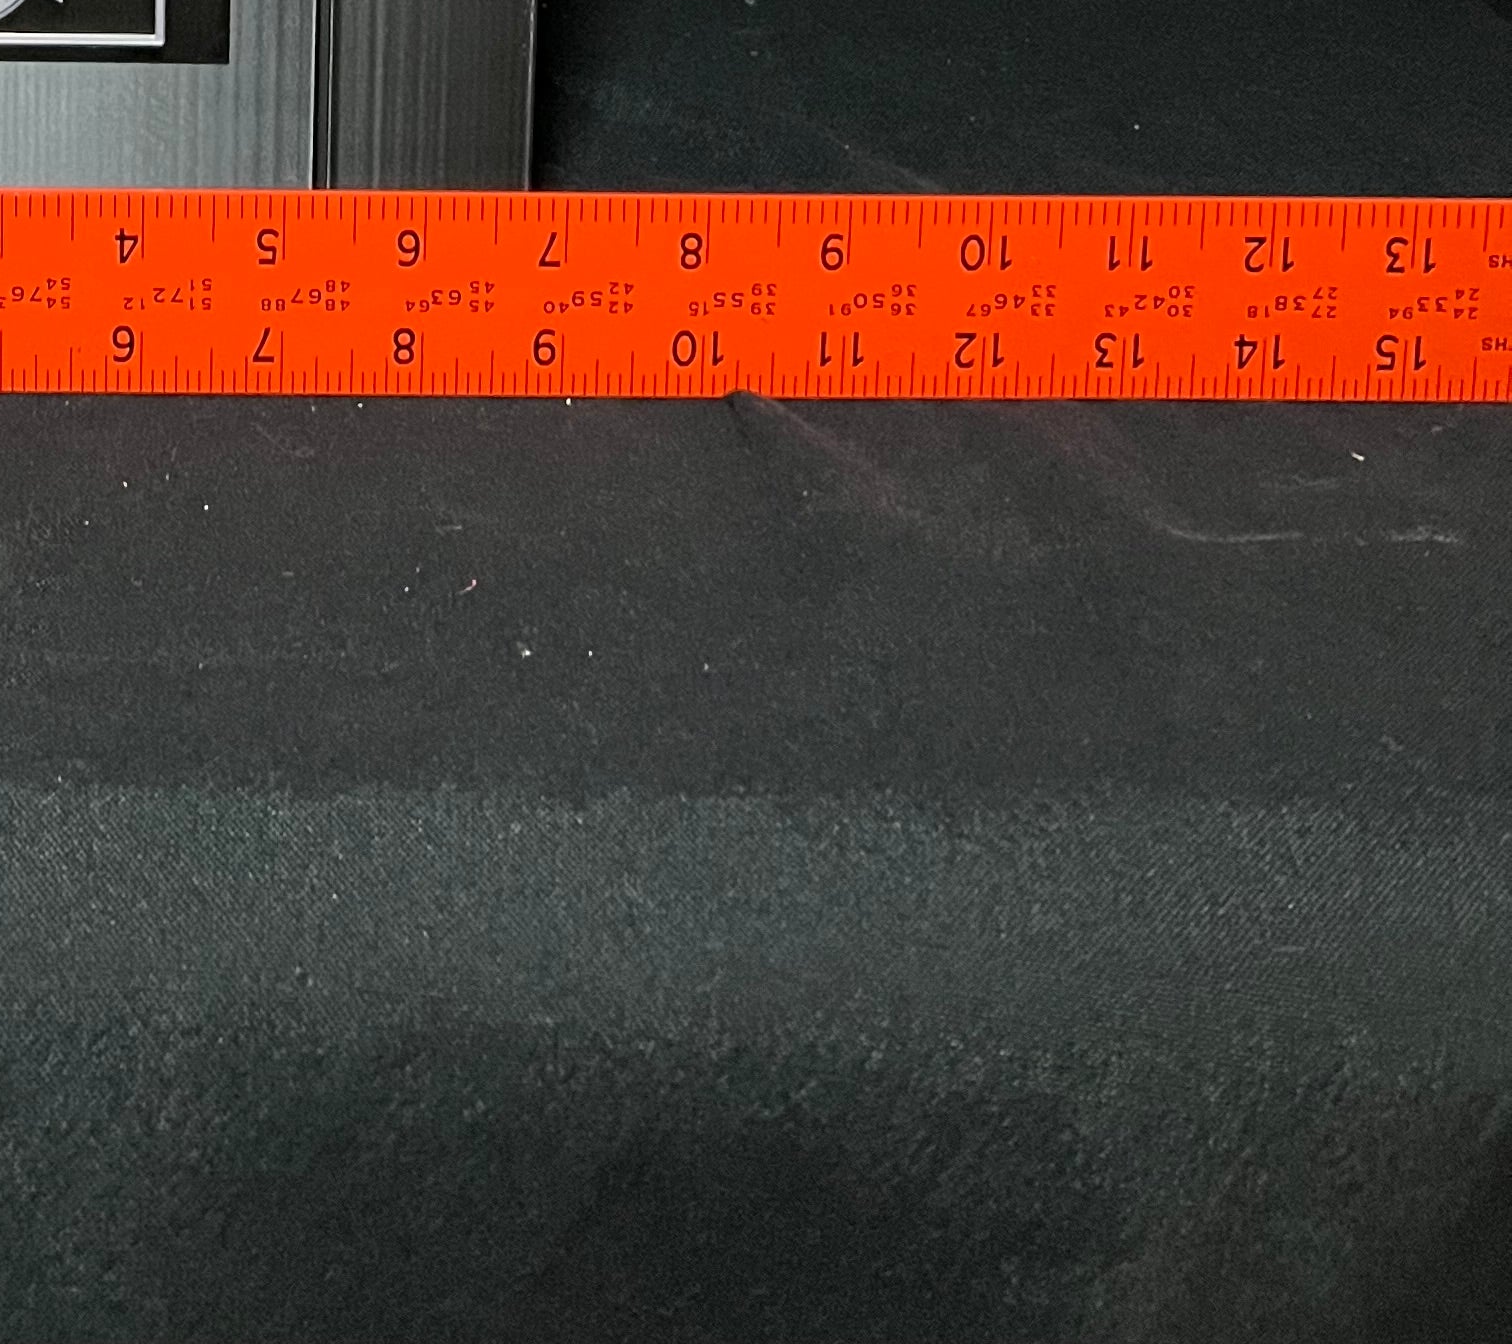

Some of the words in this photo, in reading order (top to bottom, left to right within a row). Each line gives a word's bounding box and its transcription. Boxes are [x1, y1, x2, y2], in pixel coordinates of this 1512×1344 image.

[115, 228, 138, 264] 4
[257, 229, 279, 265] 5
[398, 230, 420, 267] 6
[539, 232, 560, 267] 7
[681, 233, 703, 269] 8
[821, 234, 843, 271] 9
[960, 234, 1012, 271] 10
[1107, 235, 1153, 273] 11
[1244, 237, 1294, 273] 12
[1384, 237, 1435, 273] 13
[112, 326, 135, 362] 6
[253, 327, 274, 363] 7
[393, 328, 415, 364] 8
[533, 329, 556, 366] 9
[672, 330, 724, 367] 10
[820, 332, 864, 367] 11
[955, 333, 1004, 368] 12
[1095, 333, 1144, 368] 13
[1234, 334, 1285, 369] 14
[1376, 335, 1426, 371] 15
